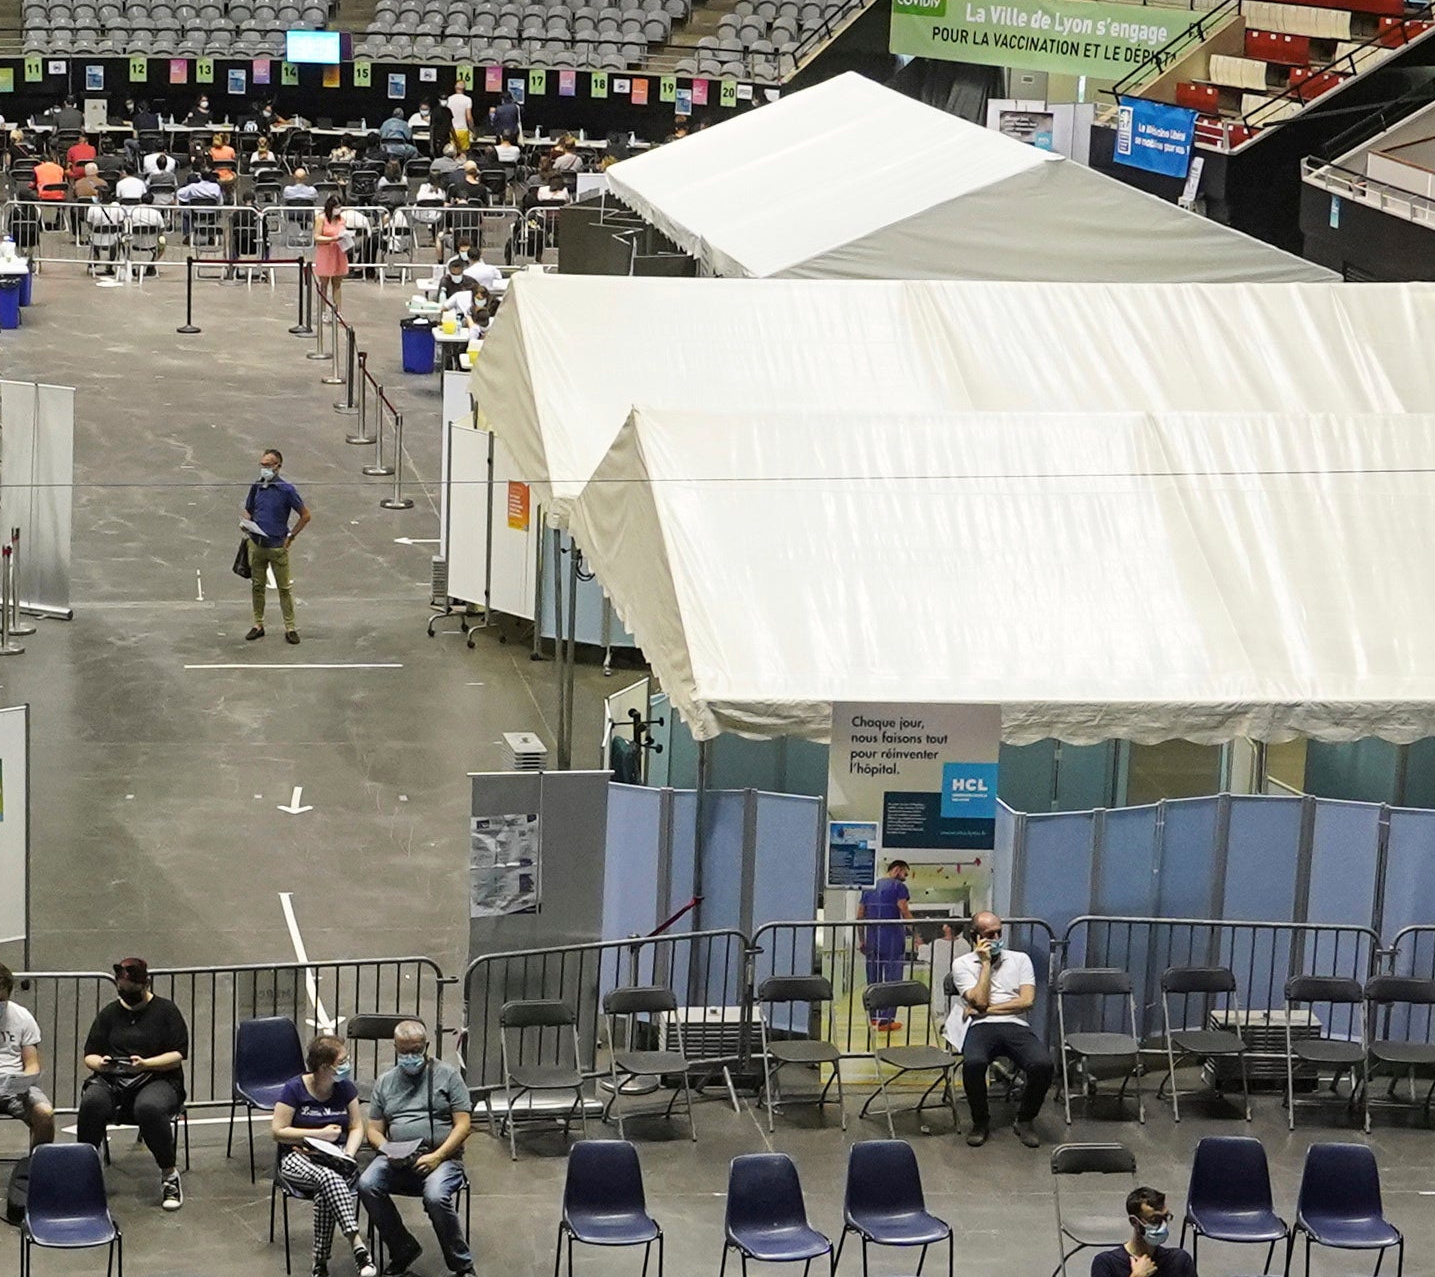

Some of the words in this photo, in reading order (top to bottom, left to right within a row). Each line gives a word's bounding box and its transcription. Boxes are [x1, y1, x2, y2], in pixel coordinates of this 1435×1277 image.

[966, 3, 985, 24] La
[991, 4, 1028, 28] Ville
[1031, 8, 1050, 30] de
[1055, 12, 1092, 38] Lyon
[932, 26, 968, 44] POUR
[973, 30, 990, 47] LA
[994, 33, 1079, 57] VACCINATION
[1083, 43, 1100, 58] ET
[1104, 46, 1121, 61] LE
[27, 64, 40, 74] 11
[132, 64, 145, 74] 12
[198, 64, 211, 74] 13
[284, 66, 297, 77] 14
[356, 68, 369, 78] 15
[458, 72, 471, 82] 16
[532, 76, 544, 86] 17
[594, 79, 606, 89] 18
[662, 83, 674, 93] 19
[723, 87, 735, 98] 20
[851, 716, 896, 730] Chaque
[899, 716, 925, 730] jour,
[851, 733, 878, 743] nous
[882, 731, 922, 744] faisons
[926, 734, 948, 744] tout
[850, 749, 877, 761] pour
[881, 748, 939, 760] réinventer
[952, 778, 988, 791] HCL
